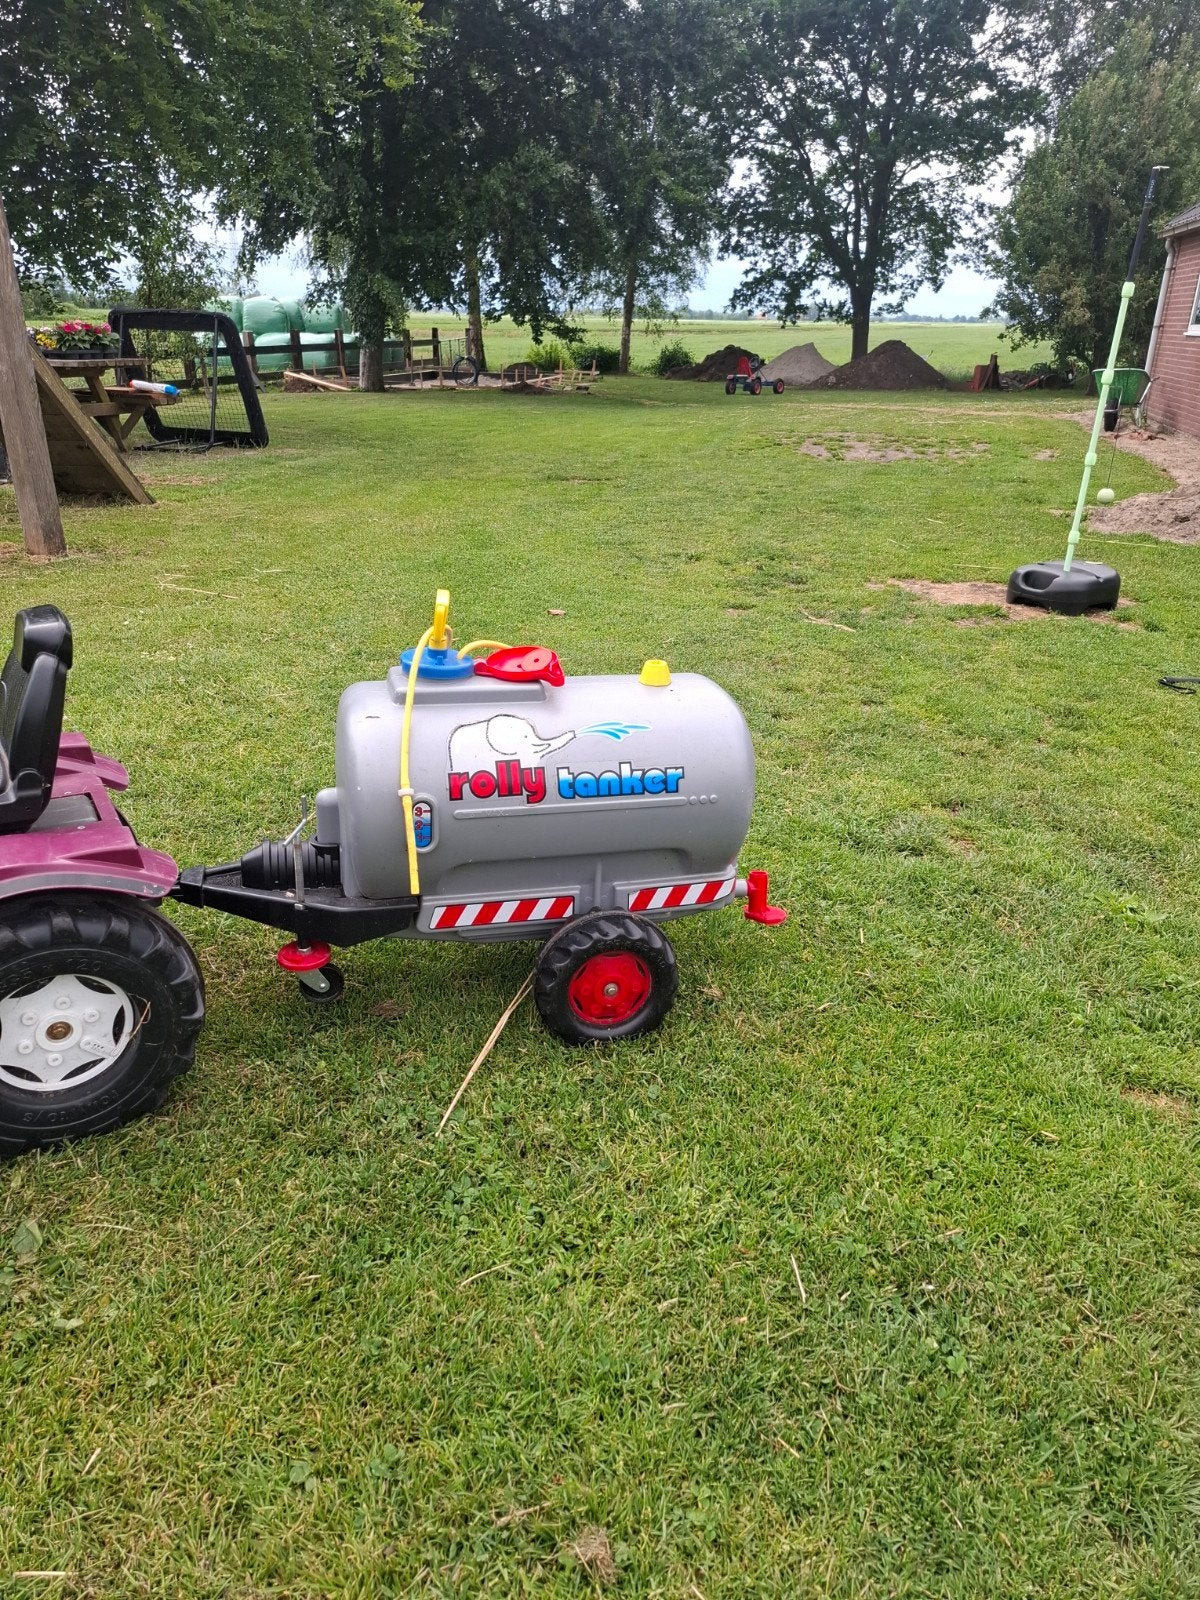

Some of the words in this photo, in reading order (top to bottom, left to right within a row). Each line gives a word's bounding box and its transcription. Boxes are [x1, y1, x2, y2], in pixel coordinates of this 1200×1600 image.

[448, 759, 546, 804] rolly
[557, 762, 684, 799] tanker
[414, 806, 423, 817] 3
